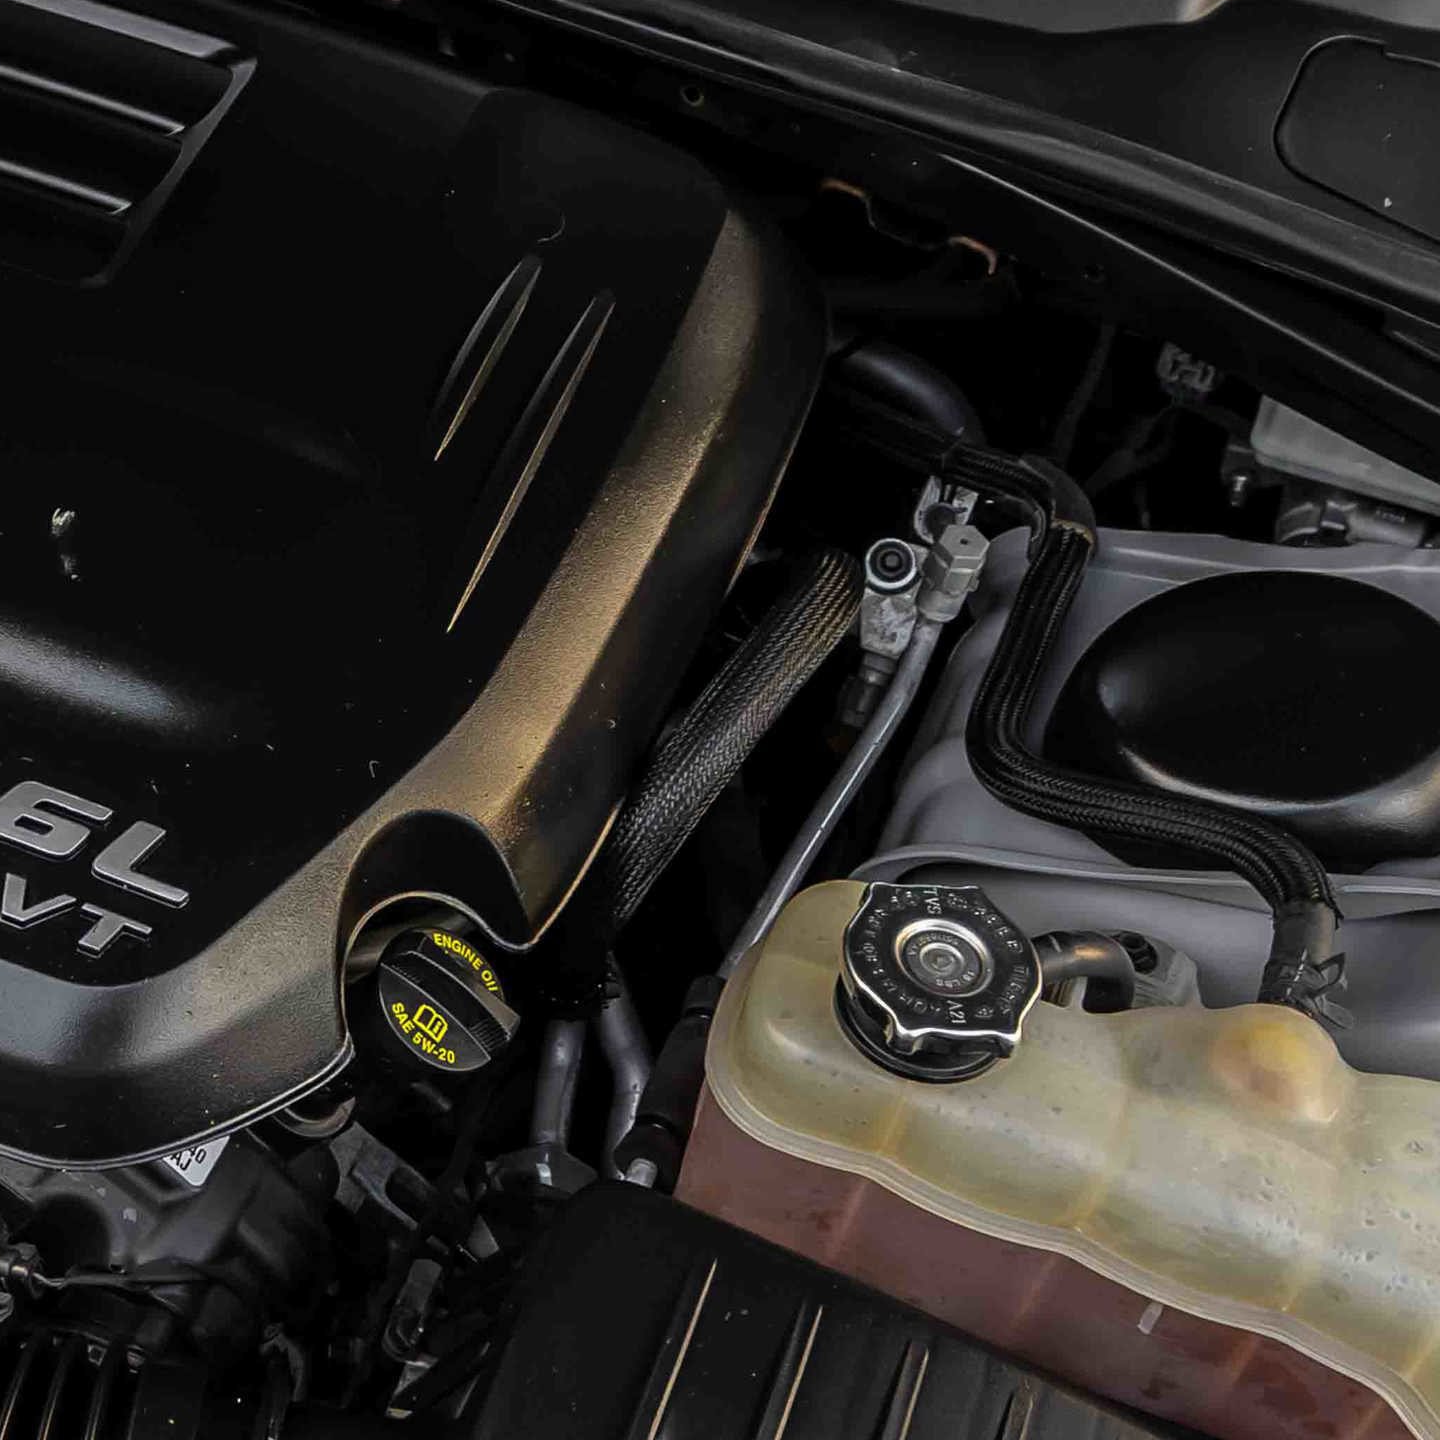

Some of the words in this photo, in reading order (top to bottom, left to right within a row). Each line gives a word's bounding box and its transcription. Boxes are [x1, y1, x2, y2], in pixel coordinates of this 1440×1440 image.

[433, 933, 484, 970] ENGINE
[392, 1002, 415, 1034] SAE
[412, 1032, 456, 1064] 5W-20
